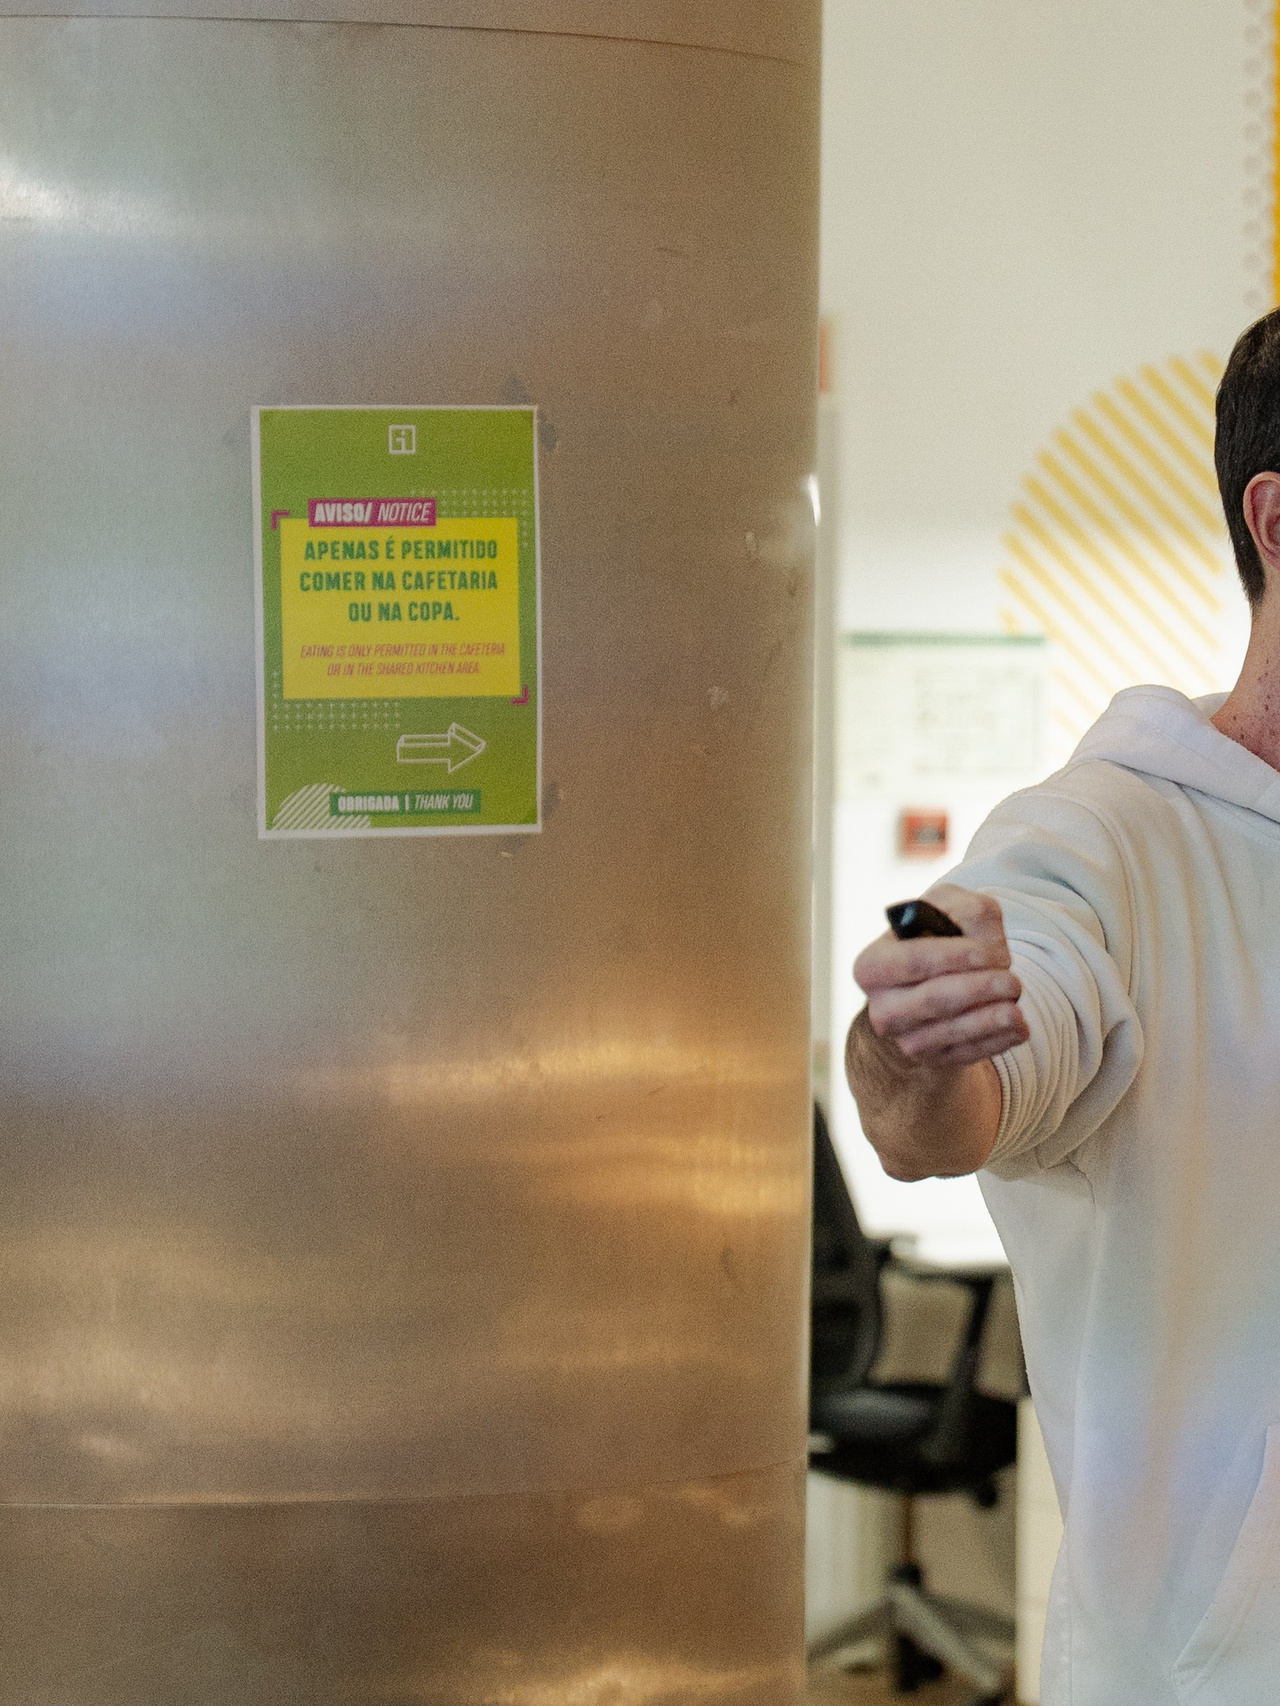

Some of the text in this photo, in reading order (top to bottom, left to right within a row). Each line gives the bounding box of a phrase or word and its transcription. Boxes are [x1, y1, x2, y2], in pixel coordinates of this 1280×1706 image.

[377, 501, 432, 522] NOTICE
[304, 534, 498, 560] APENAS É PERMITIDO
[299, 569, 499, 592] COMER NA CAFETARIA
[348, 600, 461, 622] OU NA COPA.
[301, 641, 506, 659] EATING IS ONLY PERMITTED IN THE CAFETERIA
[327, 662, 341, 676] OR
[343, 662, 355, 676] IN
[357, 661, 374, 676] THE
[376, 661, 414, 676] SHARED
[415, 660, 455, 675] KITCHEN
[337, 792, 474, 812] OBRIGADA THANK YOU
